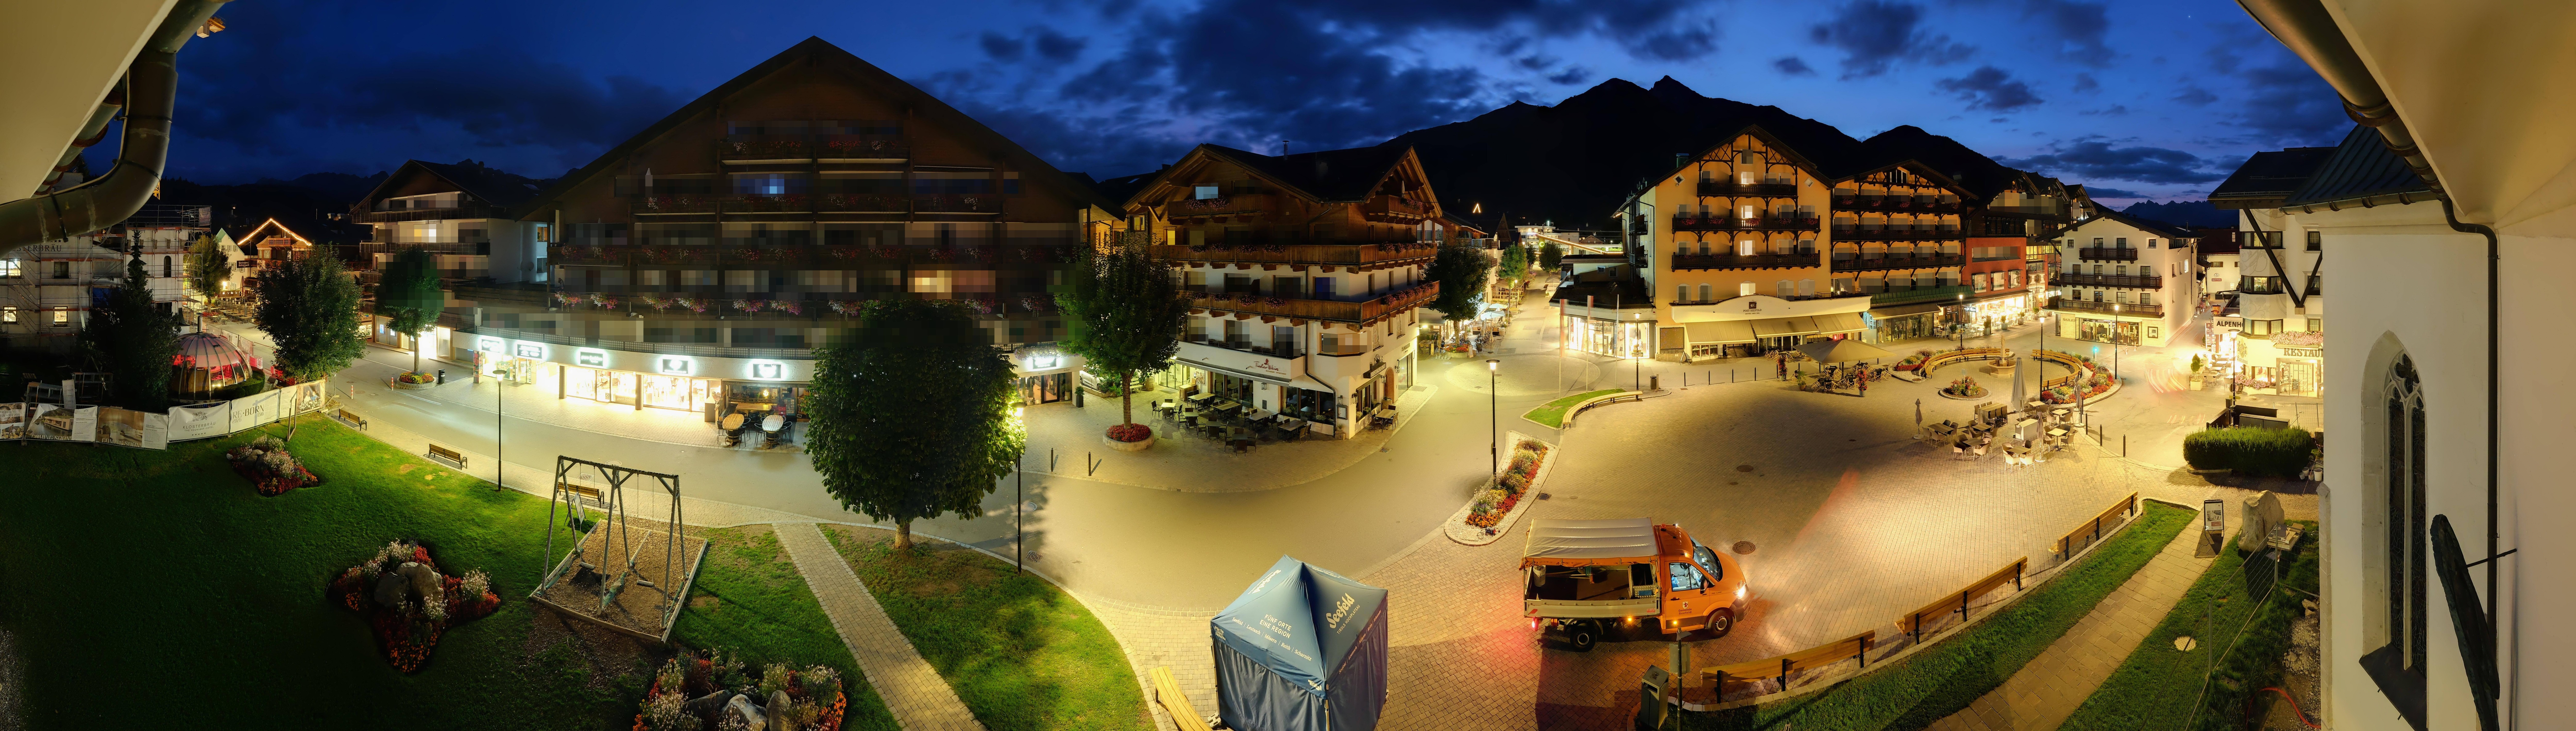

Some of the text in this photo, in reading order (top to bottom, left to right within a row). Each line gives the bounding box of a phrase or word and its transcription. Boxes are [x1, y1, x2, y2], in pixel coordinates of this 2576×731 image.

[1402, 343, 1410, 351] SAILER
[1371, 364, 1385, 377] RESTAURANT
[1326, 592, 1354, 628] Seefeld
[1337, 605, 1360, 634] TIROLS HOCHPLATEAU
[1259, 619, 1291, 639] EINE REGION
[1264, 614, 1292, 631] FÜNF ORTE
[1232, 617, 1312, 661] Seefeld Leutasch Mösern Reith Scharnitz
